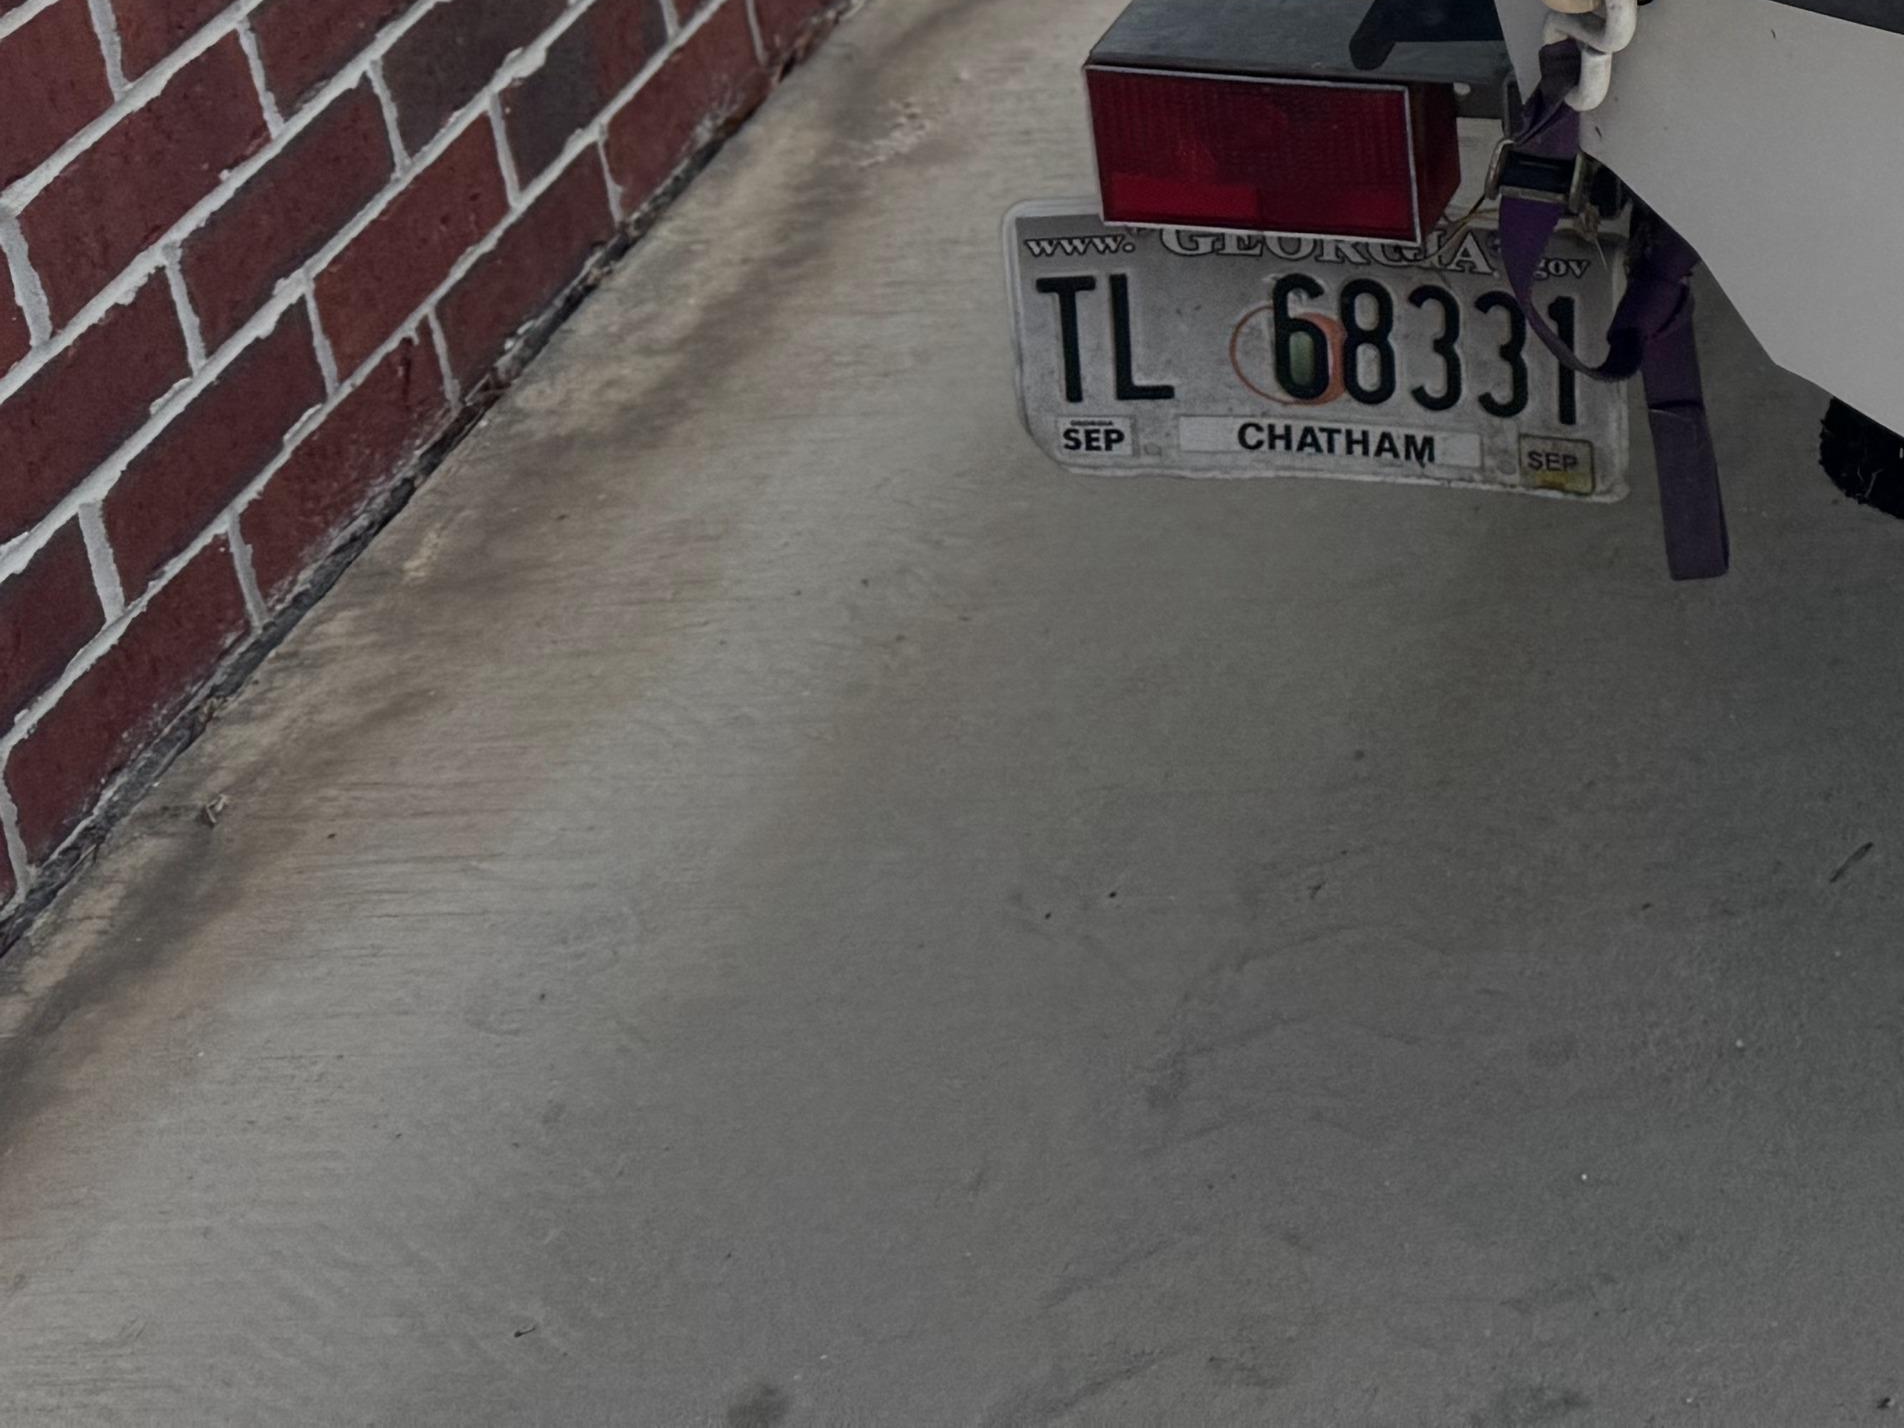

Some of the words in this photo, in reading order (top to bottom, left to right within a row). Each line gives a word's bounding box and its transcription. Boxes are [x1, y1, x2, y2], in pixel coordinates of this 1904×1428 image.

[1025, 234, 1136, 257] www.
[1036, 273, 1175, 403] TL
[1271, 273, 1577, 425] 68331
[1062, 428, 1126, 451] SEP
[1237, 422, 1436, 464] CHATHAM
[1527, 450, 1579, 472] SEP
